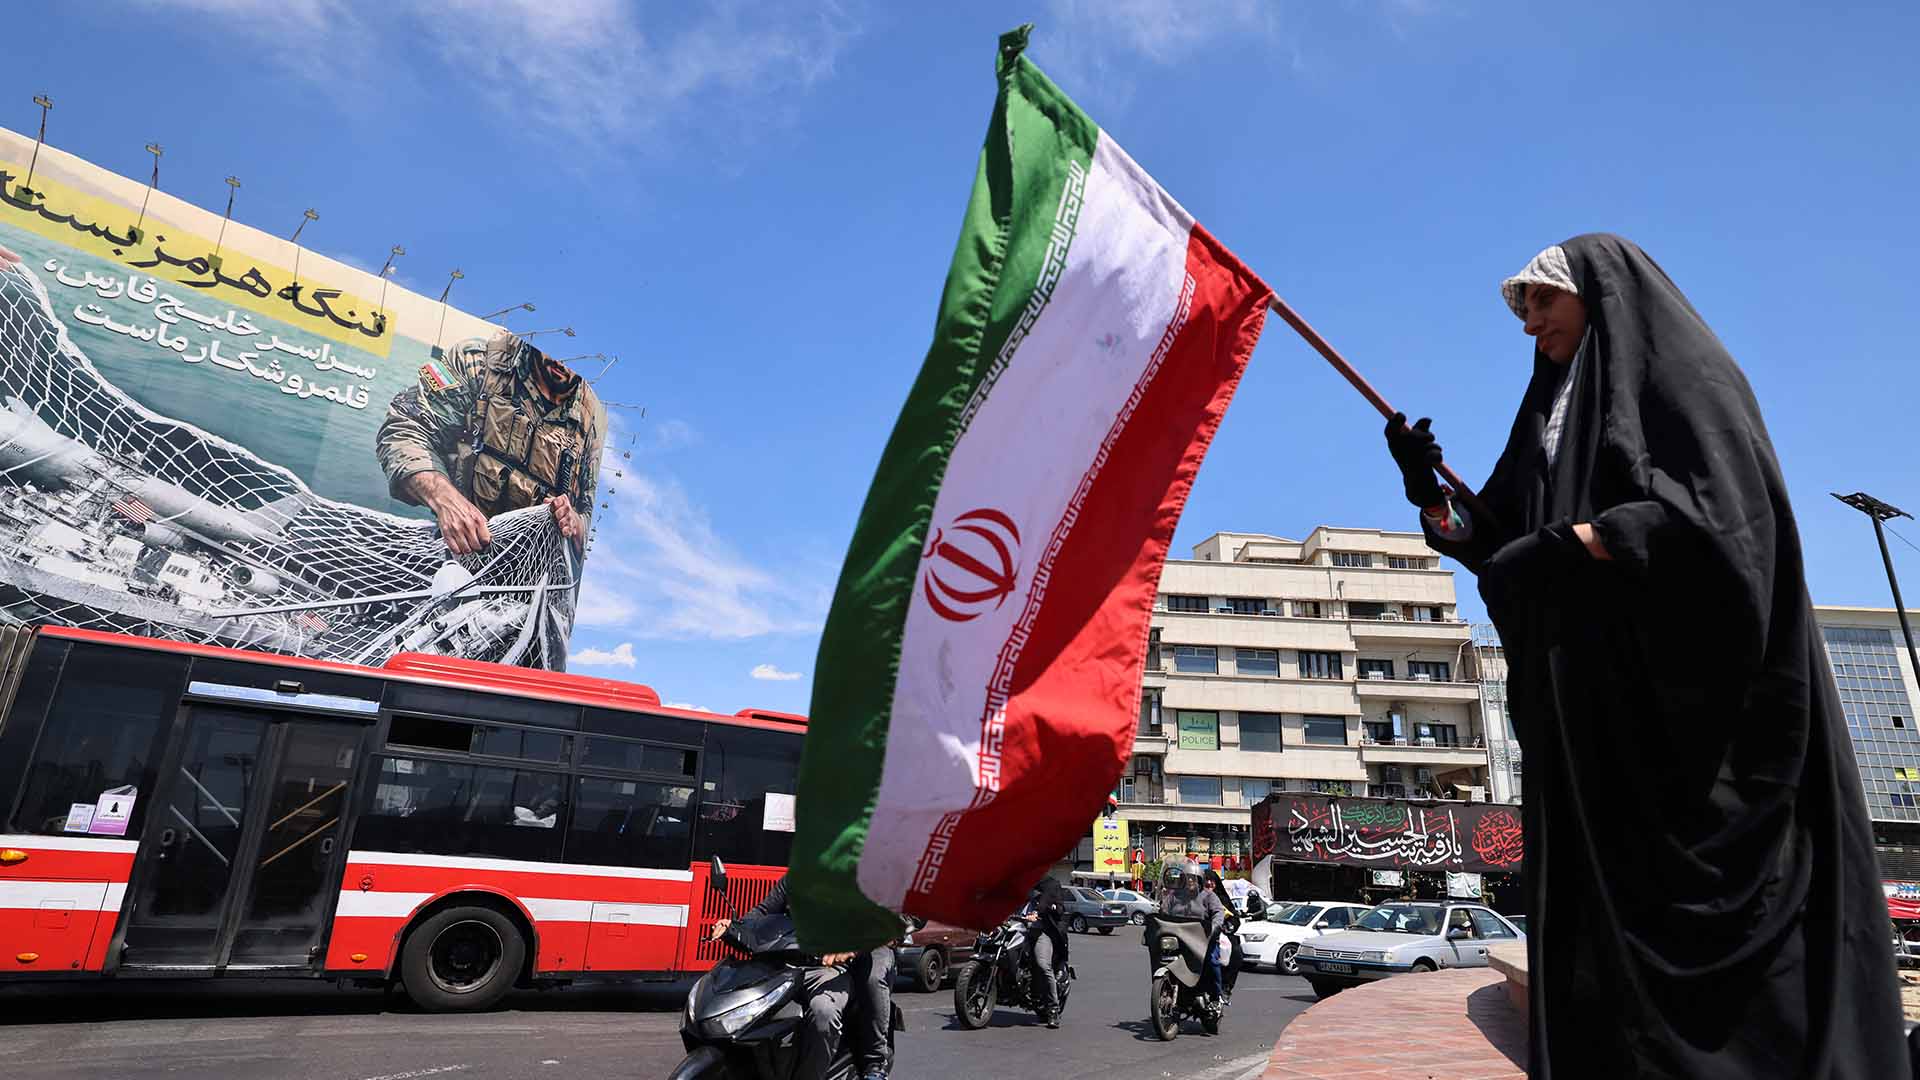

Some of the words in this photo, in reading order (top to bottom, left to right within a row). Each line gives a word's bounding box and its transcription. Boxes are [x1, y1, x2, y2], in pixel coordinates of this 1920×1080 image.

[128, 235, 271, 298] هرمز
[73, 303, 189, 352] ماست
[154, 293, 262, 336] خلیج
[278, 284, 385, 338] تنگه
[182, 340, 286, 384] شکار
[255, 335, 377, 380] سراسر
[280, 374, 370, 410] قلمرو
[1181, 735, 1215, 745] POLICE
